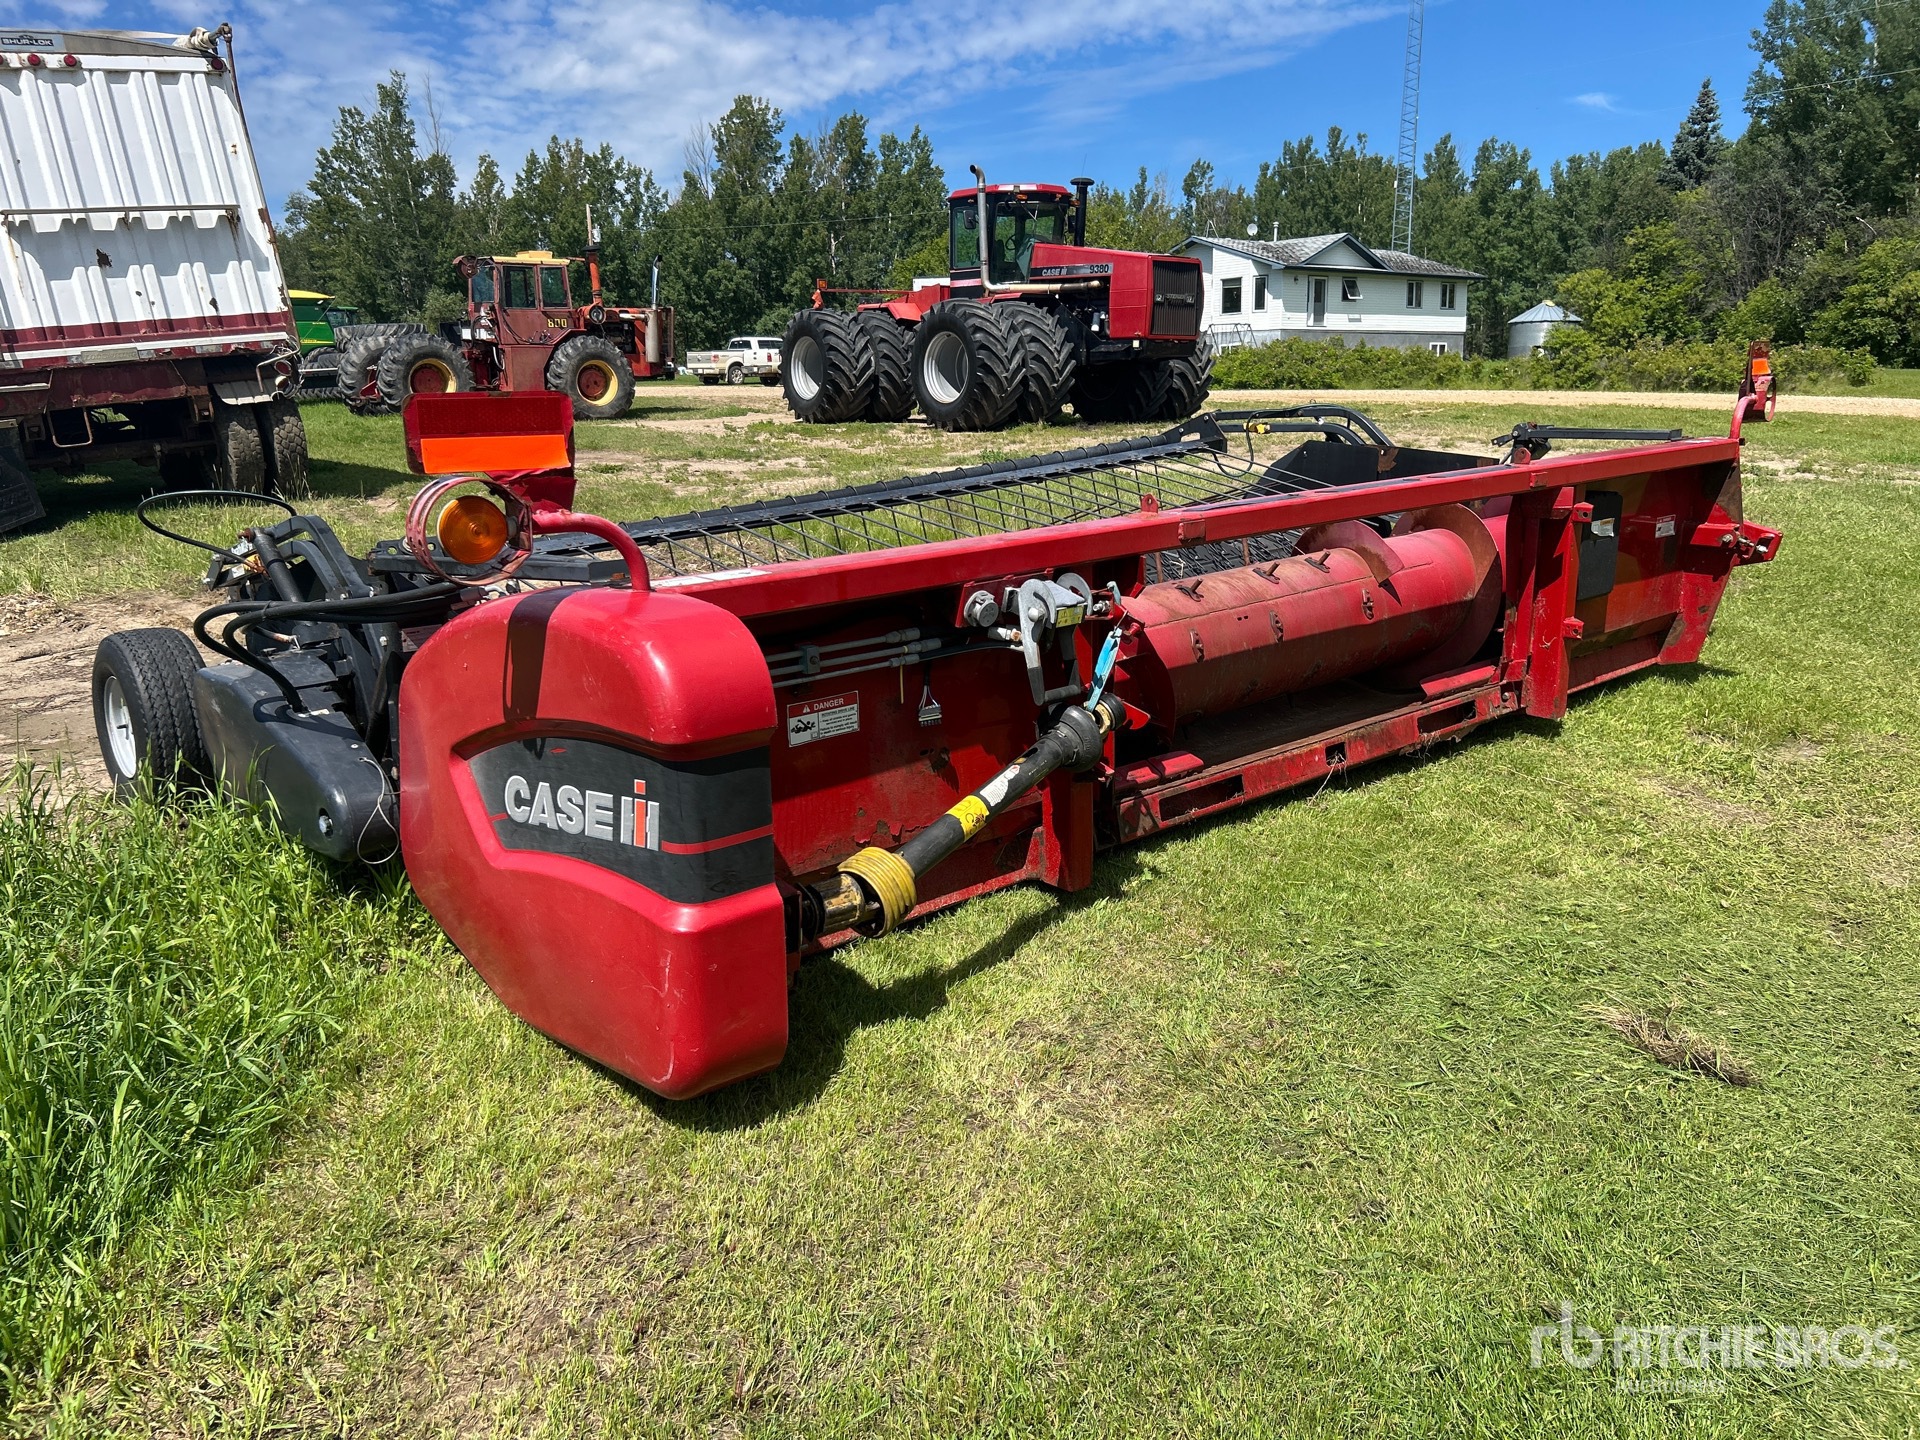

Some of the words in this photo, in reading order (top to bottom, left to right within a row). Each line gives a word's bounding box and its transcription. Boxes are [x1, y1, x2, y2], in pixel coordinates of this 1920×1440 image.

[1042, 268, 1060, 277] CASE
[1089, 264, 1109, 274] 9380
[547, 318, 568, 328] 800
[814, 698, 844, 711] DANGER
[504, 775, 614, 842] CASE
